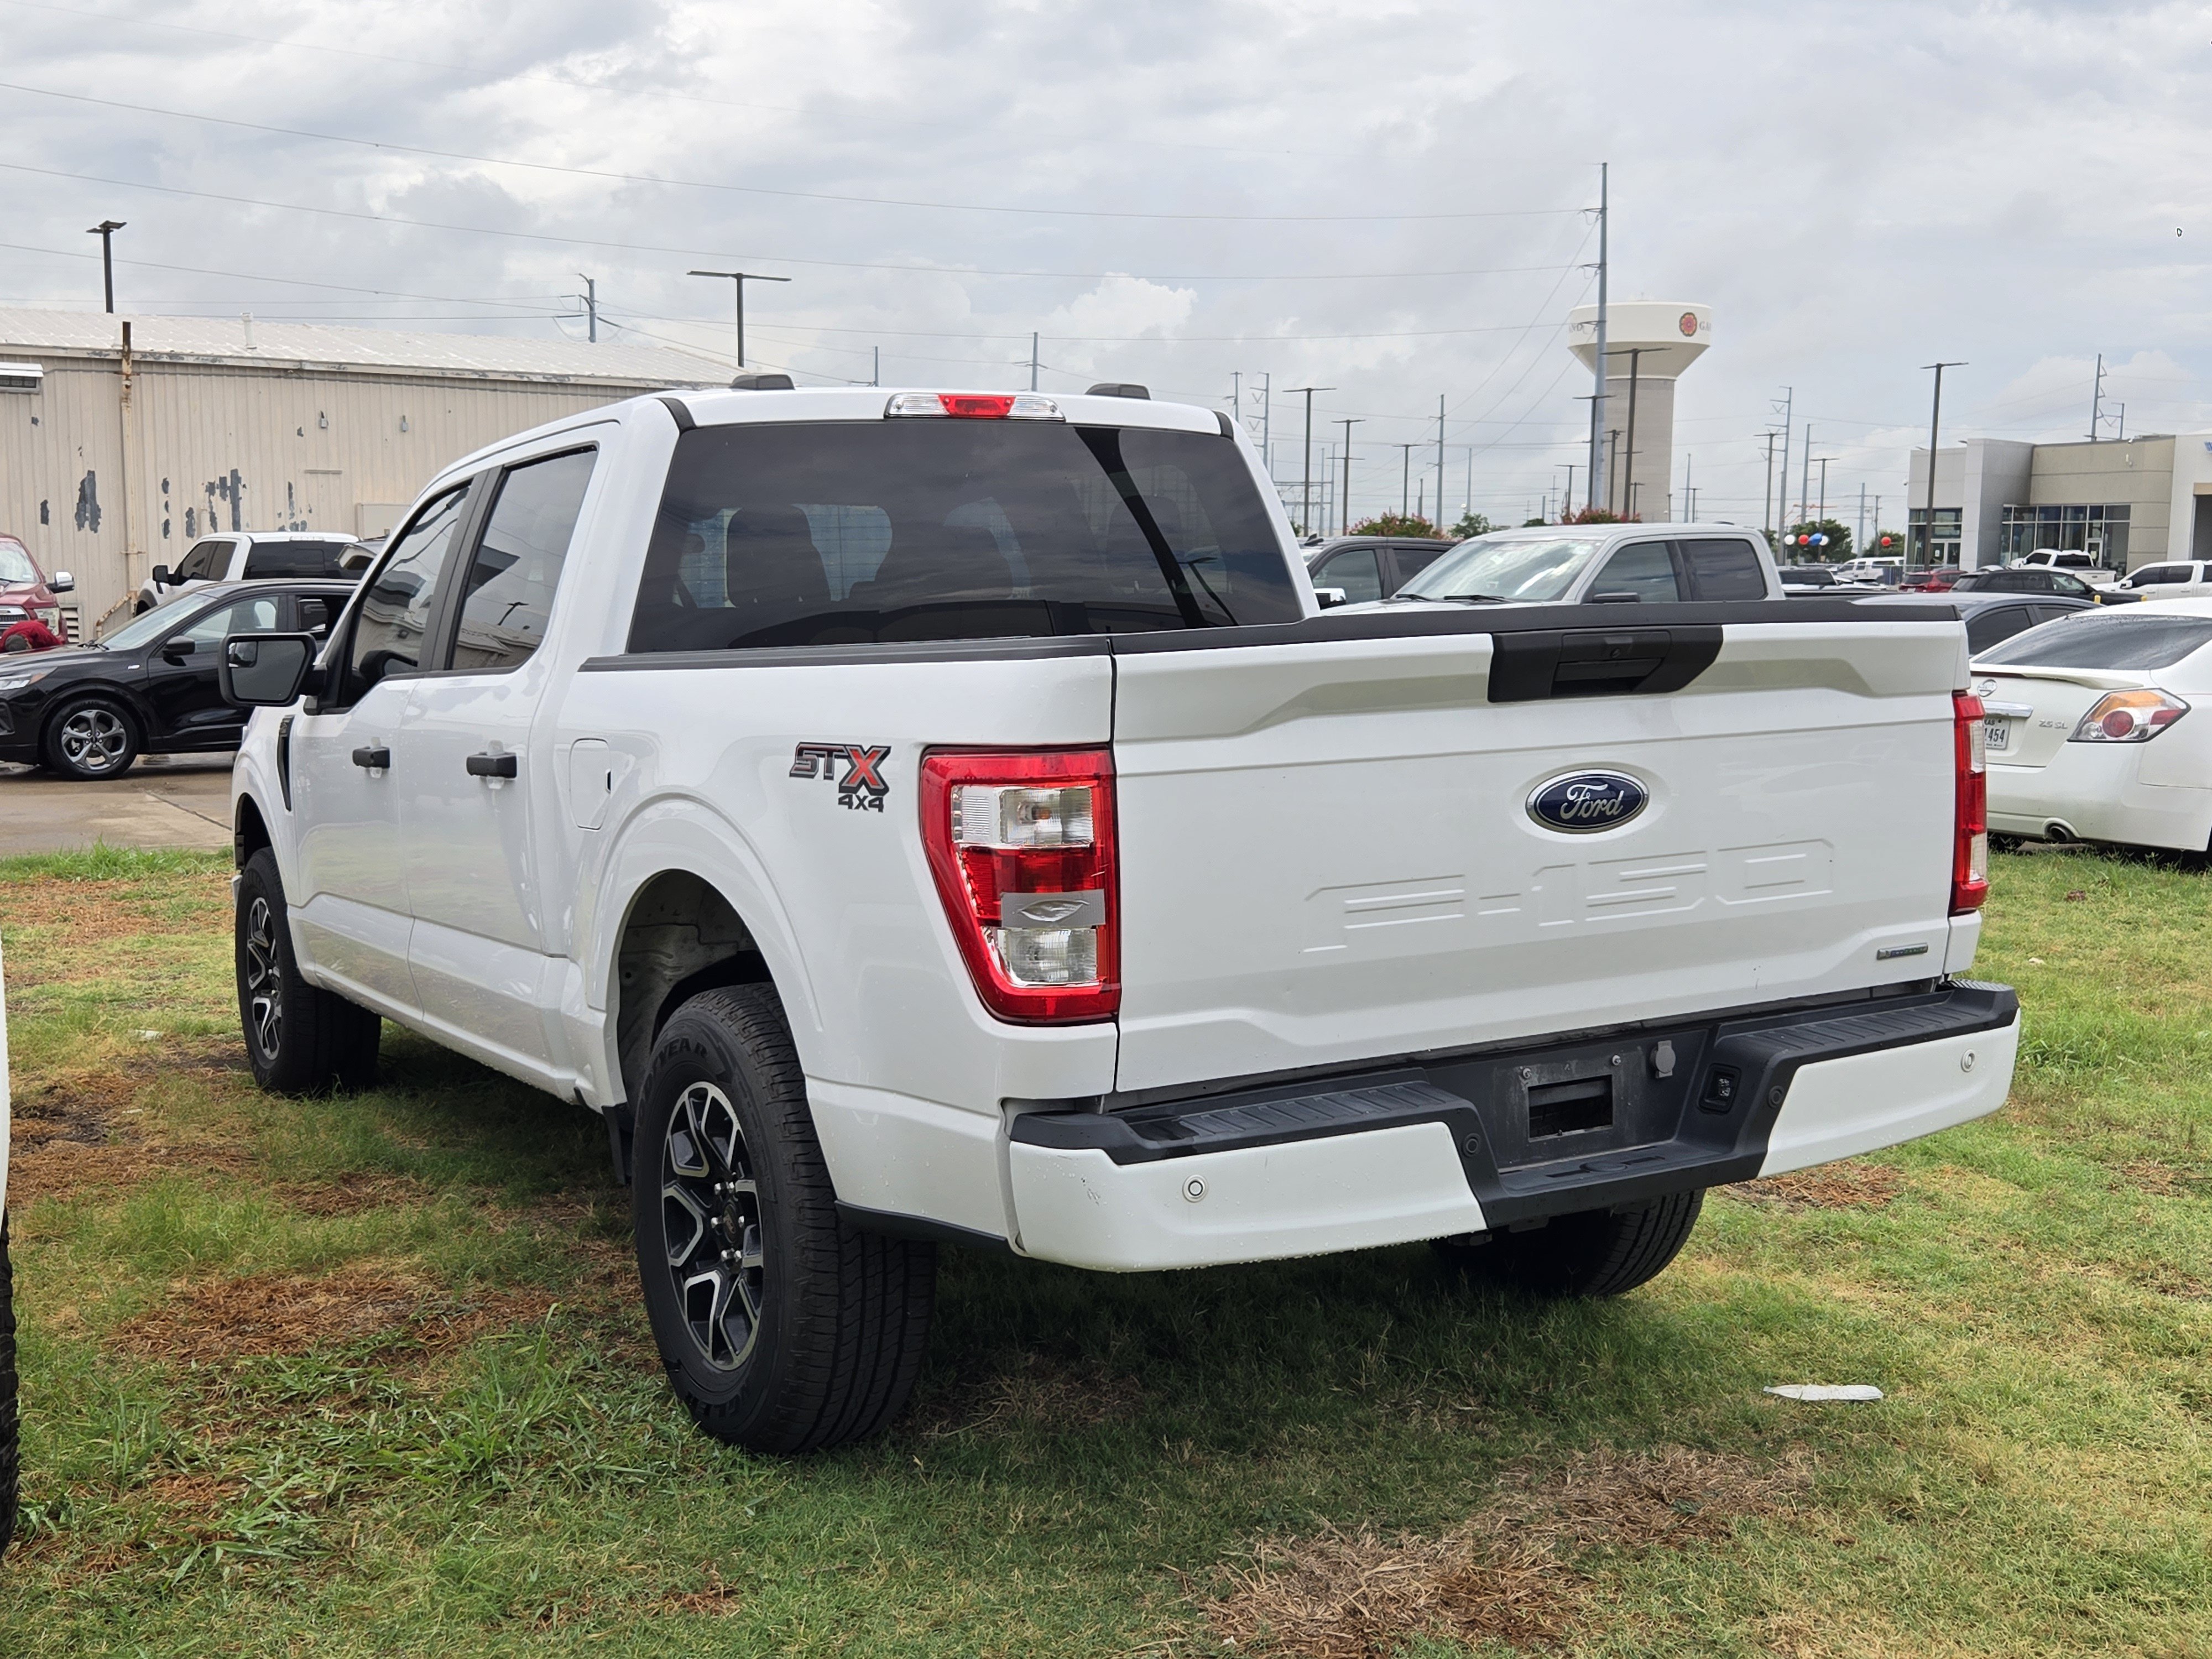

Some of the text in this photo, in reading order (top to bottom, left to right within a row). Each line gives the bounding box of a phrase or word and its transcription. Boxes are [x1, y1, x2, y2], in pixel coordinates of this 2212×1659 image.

[789, 742, 891, 796] STX
[1560, 784, 1624, 820] Ford
[1304, 839, 1834, 952] F-150
